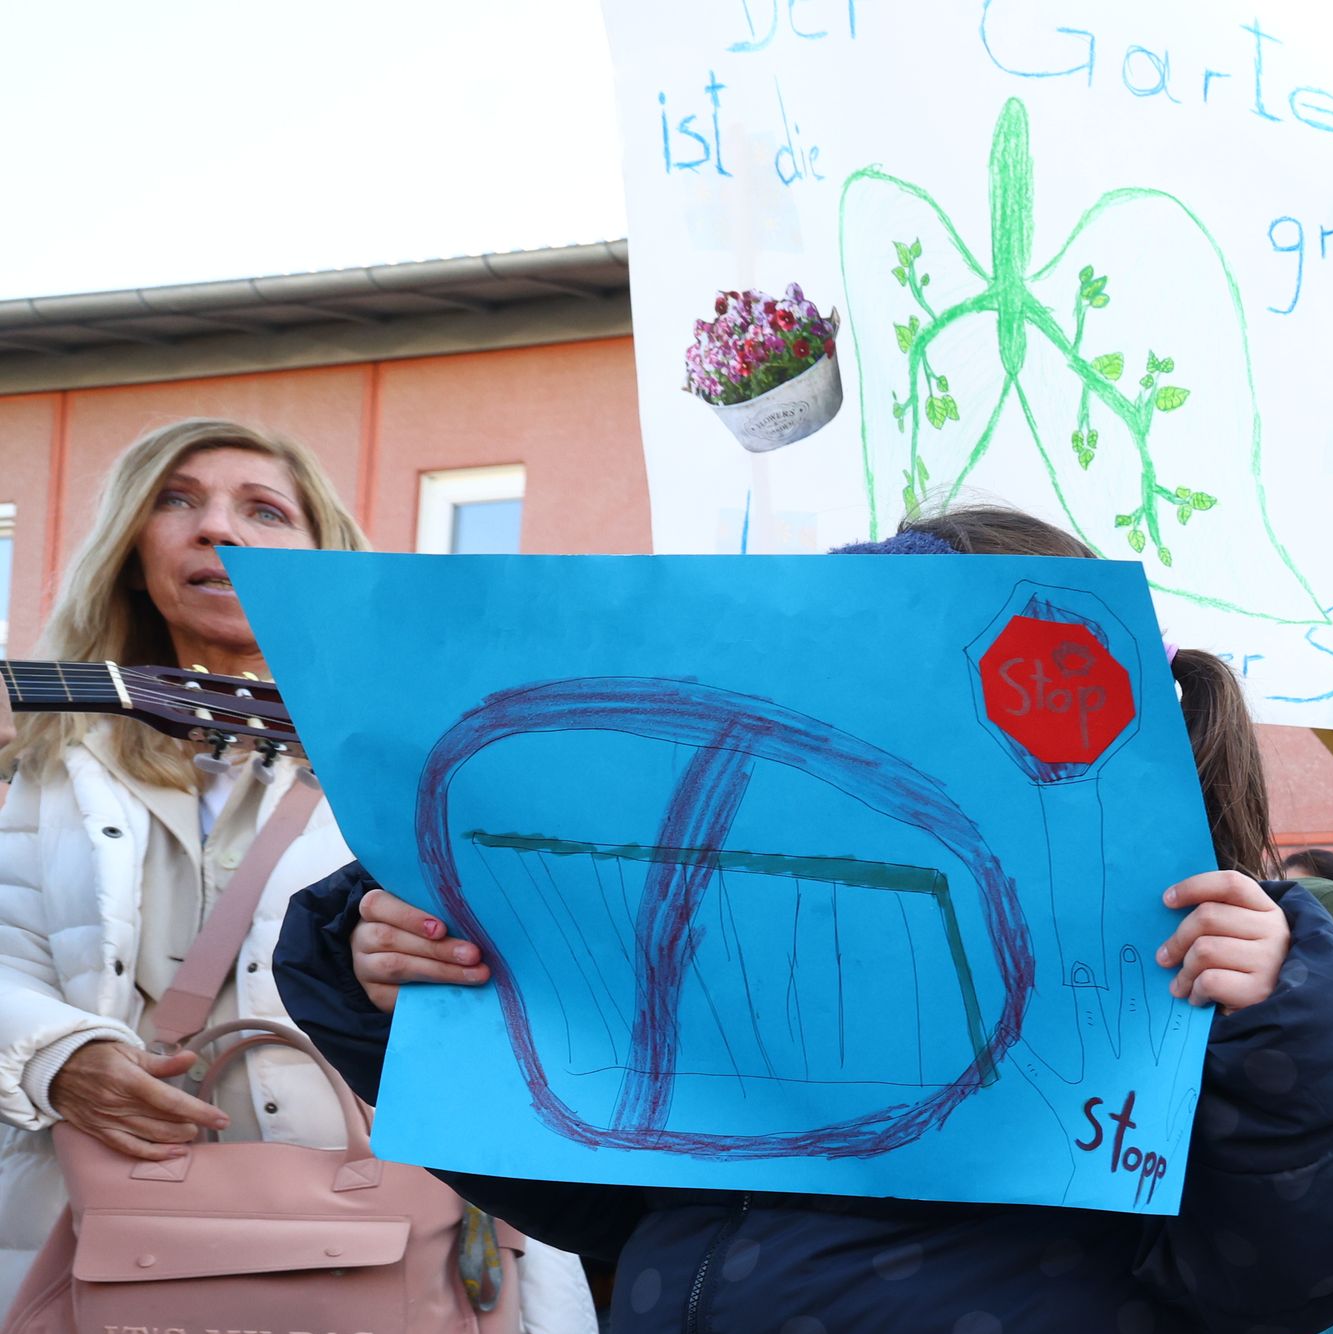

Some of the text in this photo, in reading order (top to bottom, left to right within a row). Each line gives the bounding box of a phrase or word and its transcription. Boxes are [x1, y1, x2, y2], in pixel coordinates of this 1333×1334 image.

[658, 69, 826, 187] ist die
[1000, 656, 1106, 749] Stop
